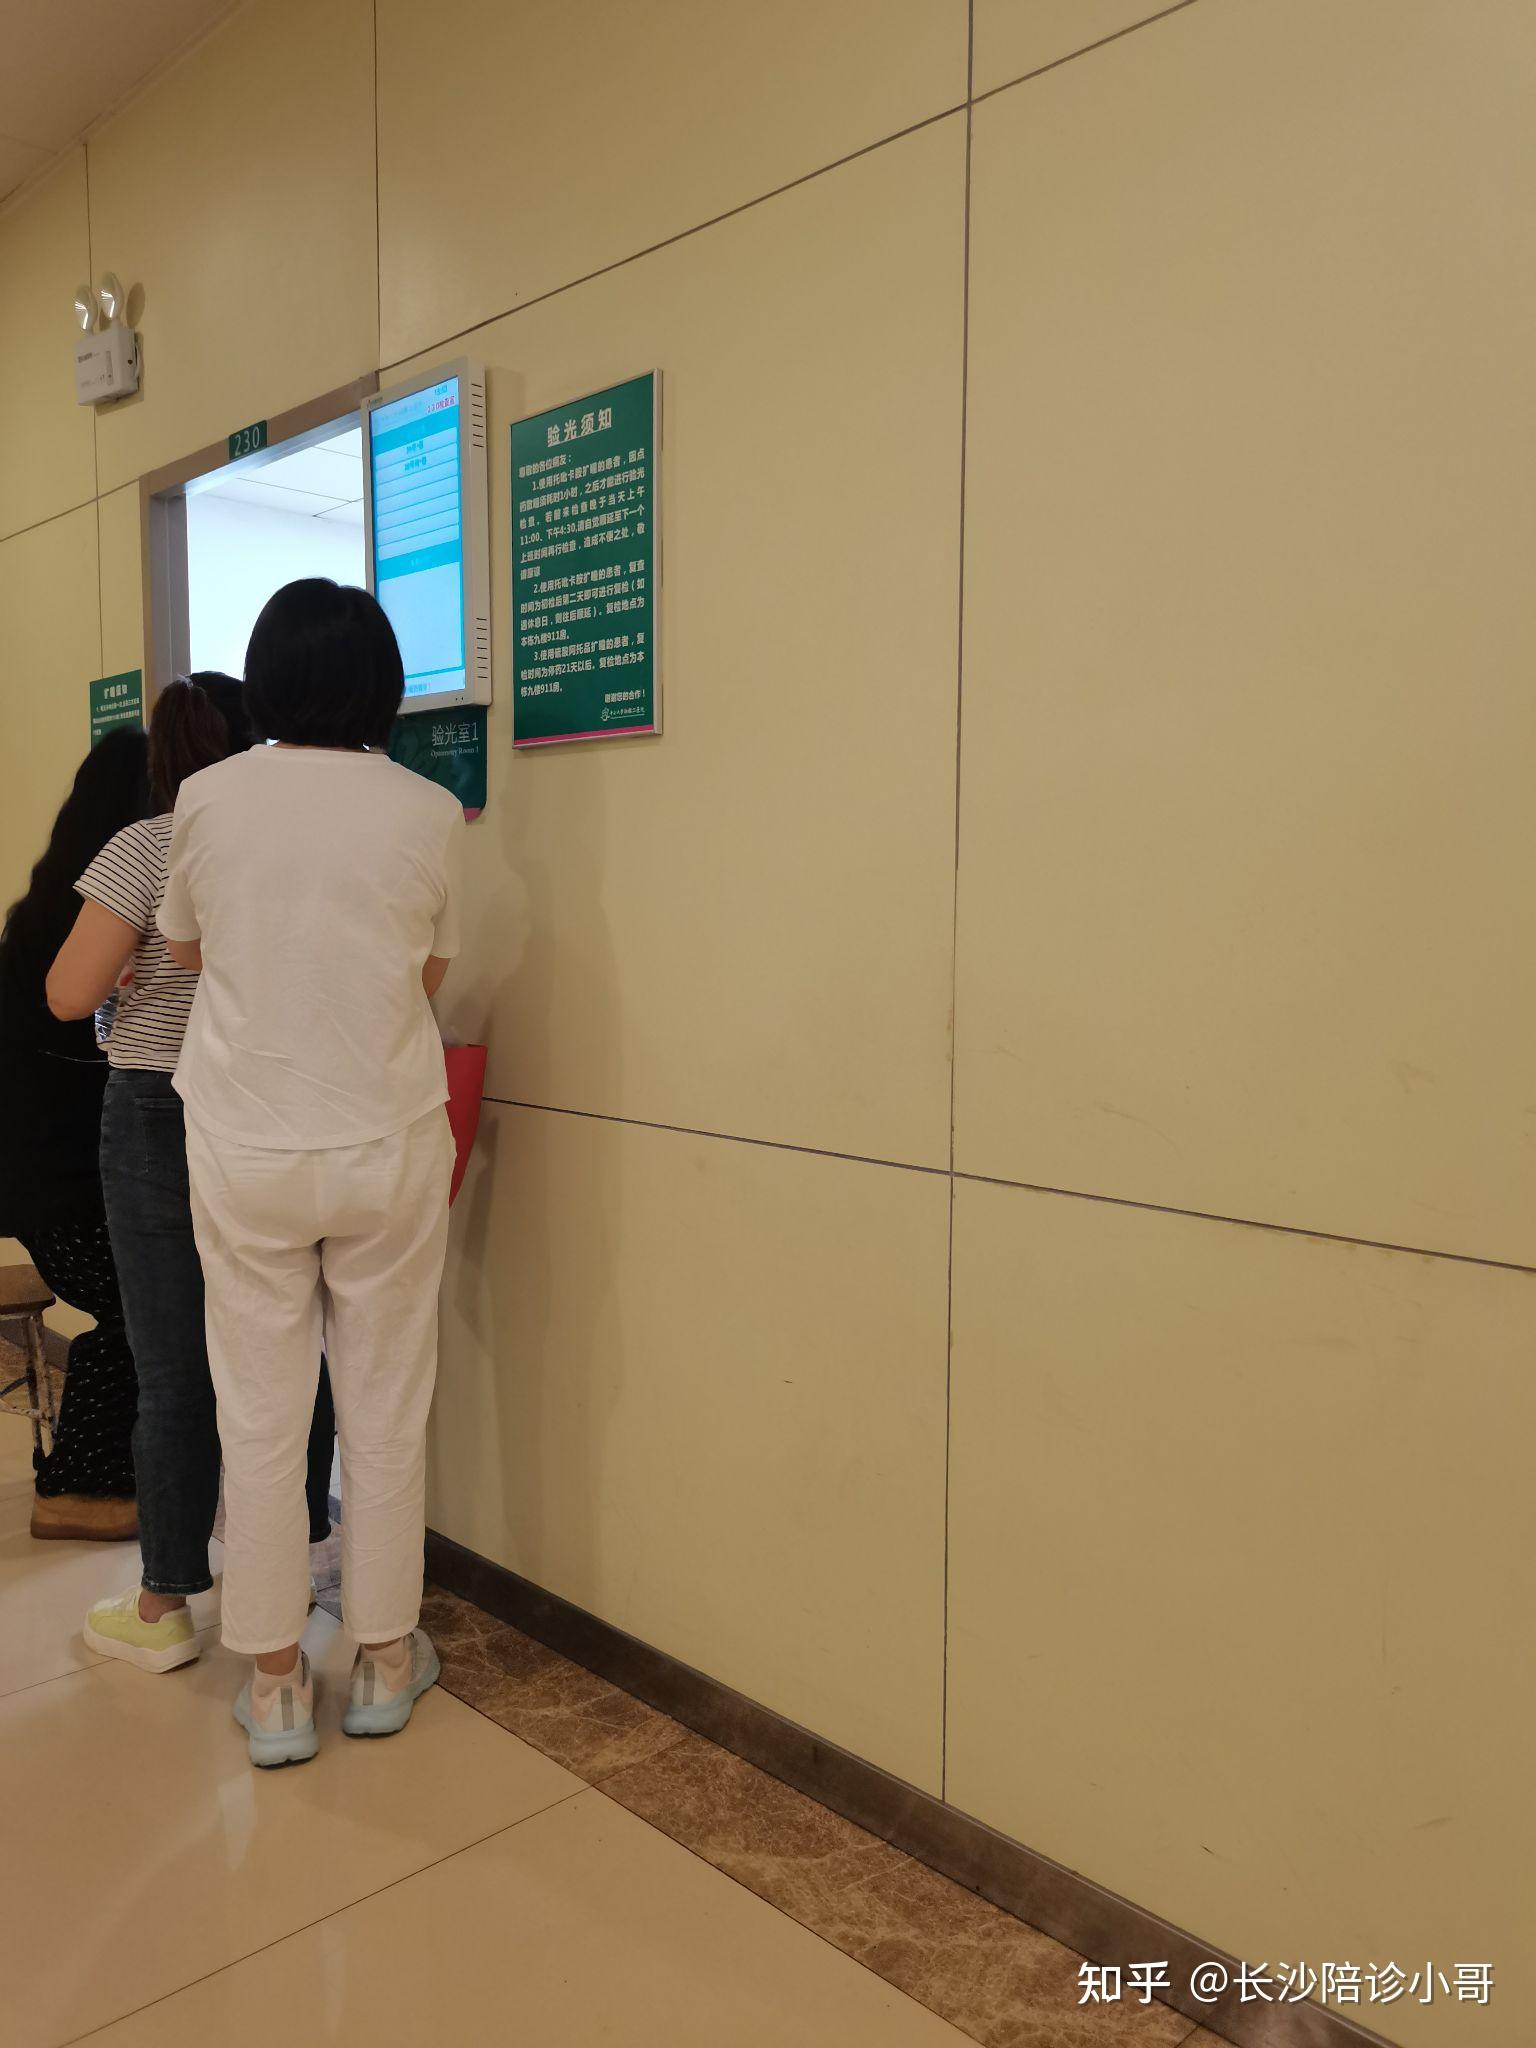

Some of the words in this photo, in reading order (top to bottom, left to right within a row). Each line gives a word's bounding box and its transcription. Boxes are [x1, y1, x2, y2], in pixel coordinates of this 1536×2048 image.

[235, 426, 260, 457] 230
[547, 408, 611, 447] 验光须知
[431, 722, 479, 746] 验光室1
